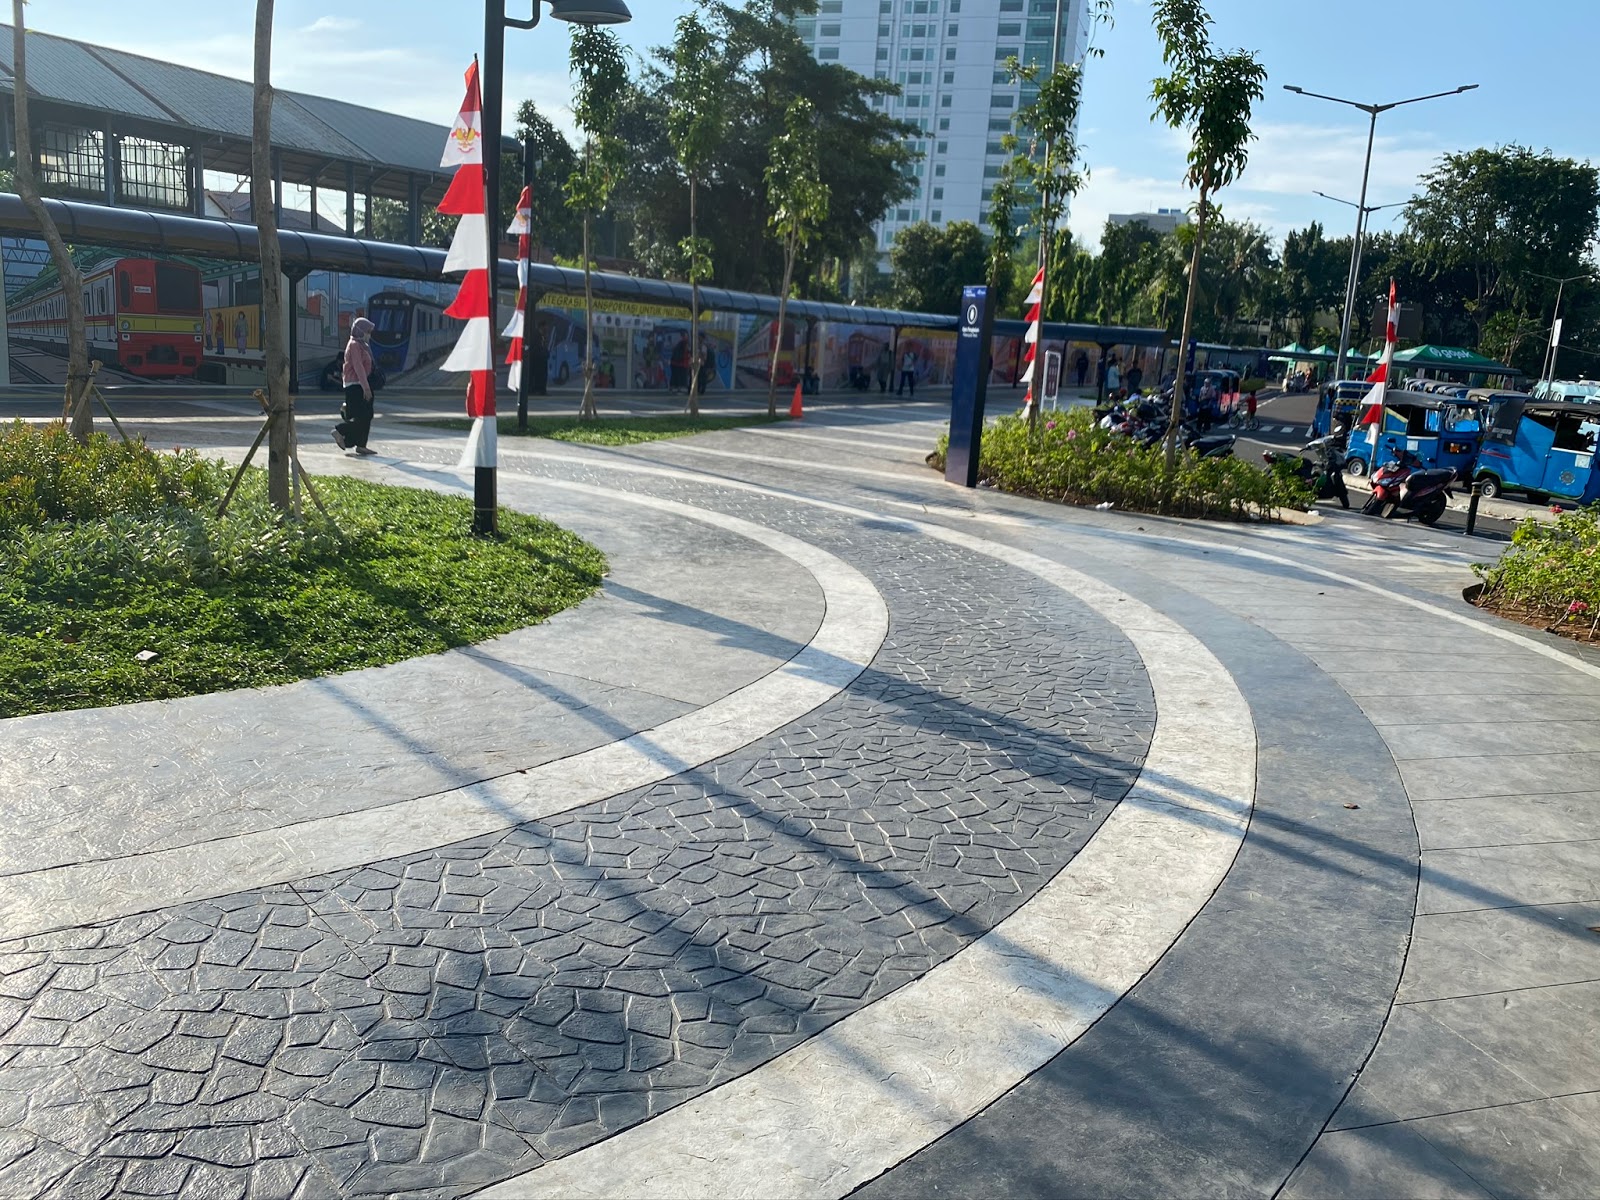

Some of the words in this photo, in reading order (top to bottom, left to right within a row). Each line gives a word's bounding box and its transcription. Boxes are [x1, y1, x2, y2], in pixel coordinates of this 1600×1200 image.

[539, 295, 582, 308] NTEGRASI
[583, 298, 640, 314] TANSPORTASI
[1441, 349, 1473, 359] gojek
